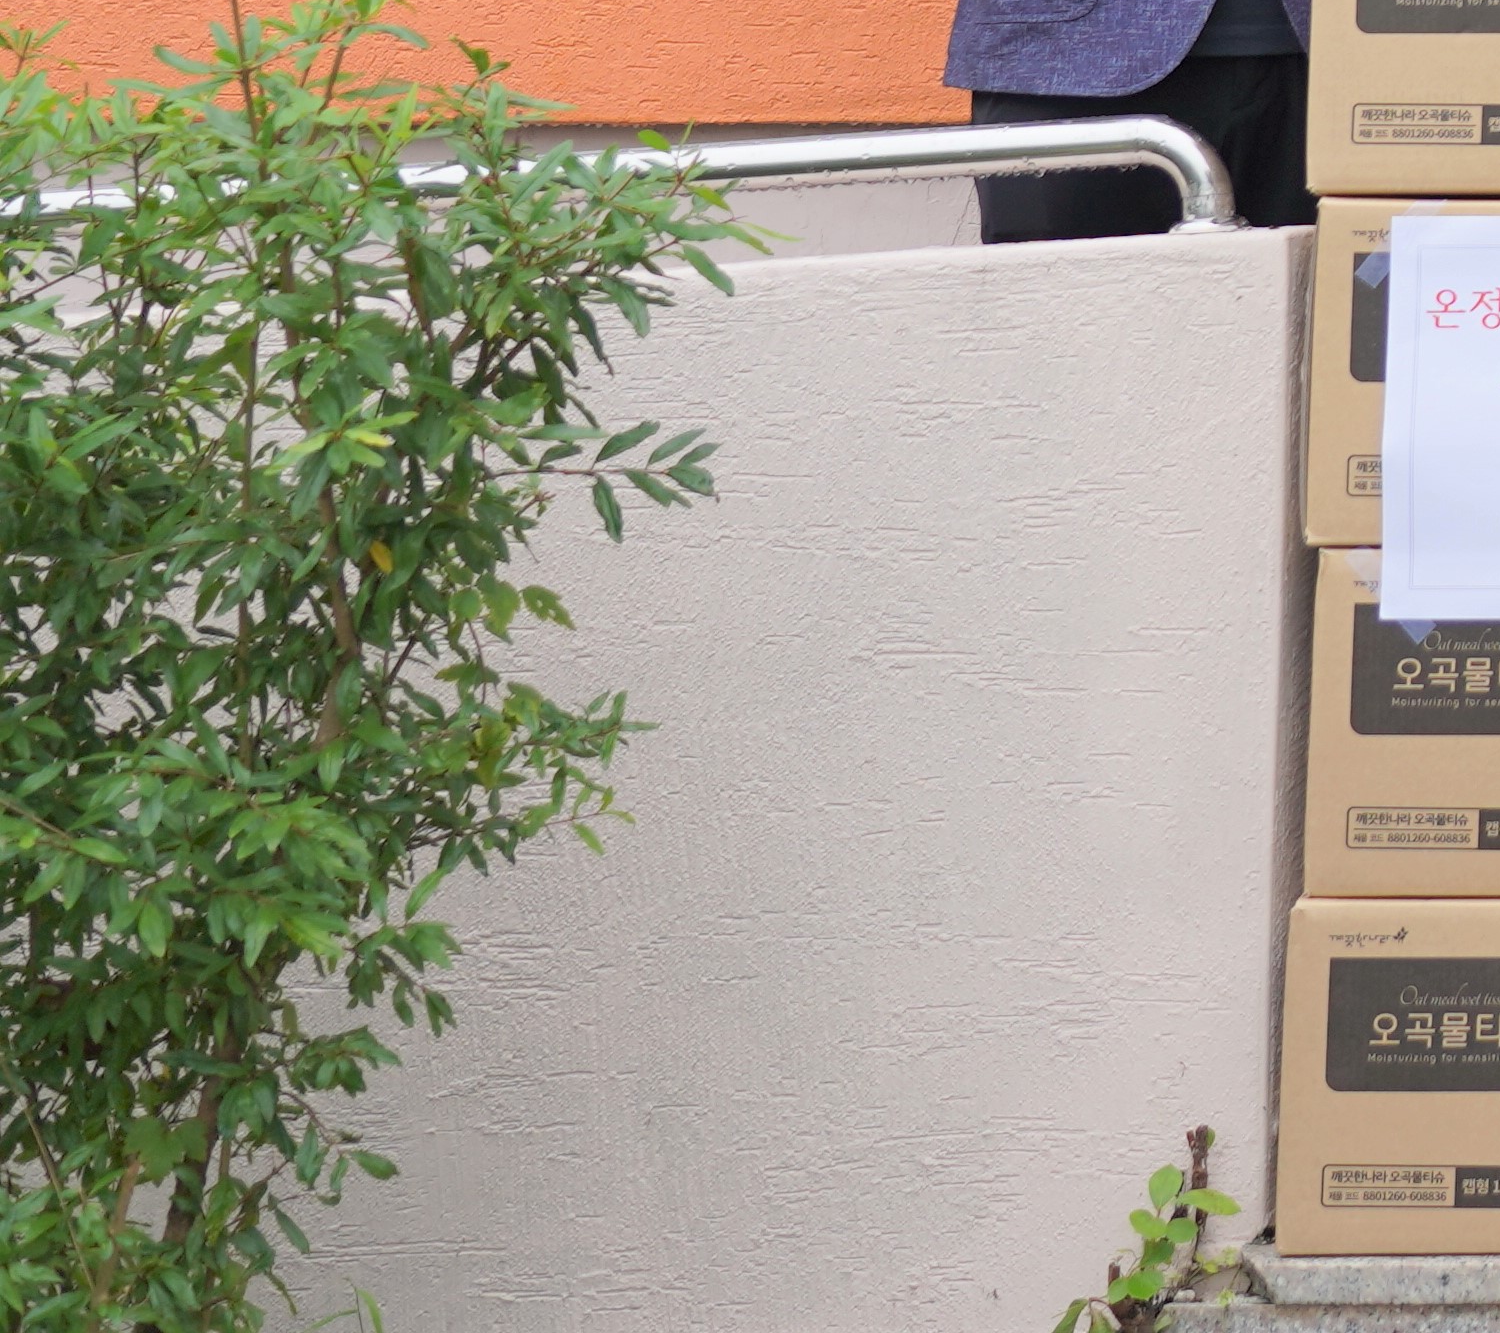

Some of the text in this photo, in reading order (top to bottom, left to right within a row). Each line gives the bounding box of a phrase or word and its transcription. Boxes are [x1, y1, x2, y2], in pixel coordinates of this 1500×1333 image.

[1400, 985, 1429, 1006] Oat
[1431, 982, 1469, 1006] meal
[1462, 995, 1482, 1005] wet
[1367, 1053, 1436, 1064] Moisturizing
[1442, 1053, 1457, 1062] for
